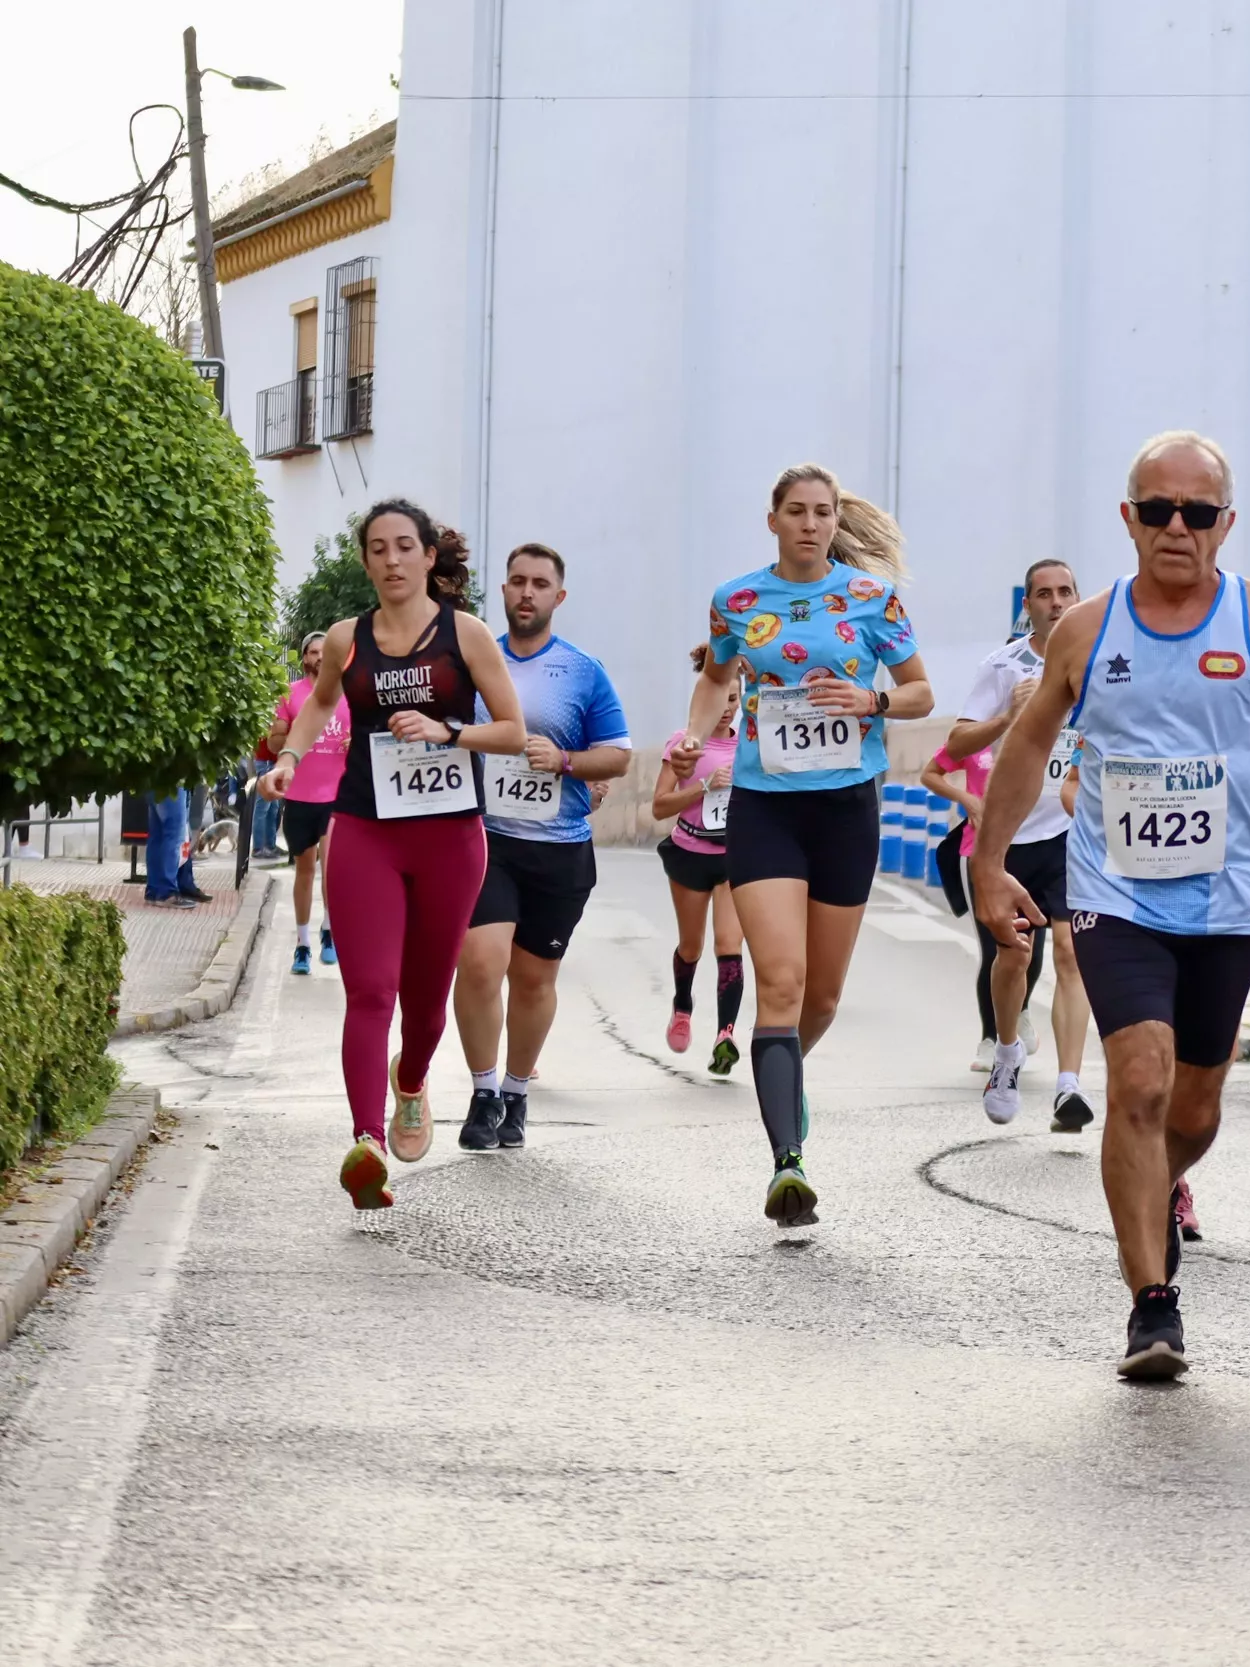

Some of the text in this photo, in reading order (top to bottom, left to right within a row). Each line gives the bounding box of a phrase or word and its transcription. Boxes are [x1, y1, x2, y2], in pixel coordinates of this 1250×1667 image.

[374, 665, 432, 691] WORKOUT
[377, 685, 434, 706] EVERYONE
[775, 719, 849, 751] 1310
[389, 763, 463, 796] 1426
[1164, 761, 1197, 776] 2024
[495, 776, 553, 803] 1425
[1119, 810, 1211, 848] 1423
